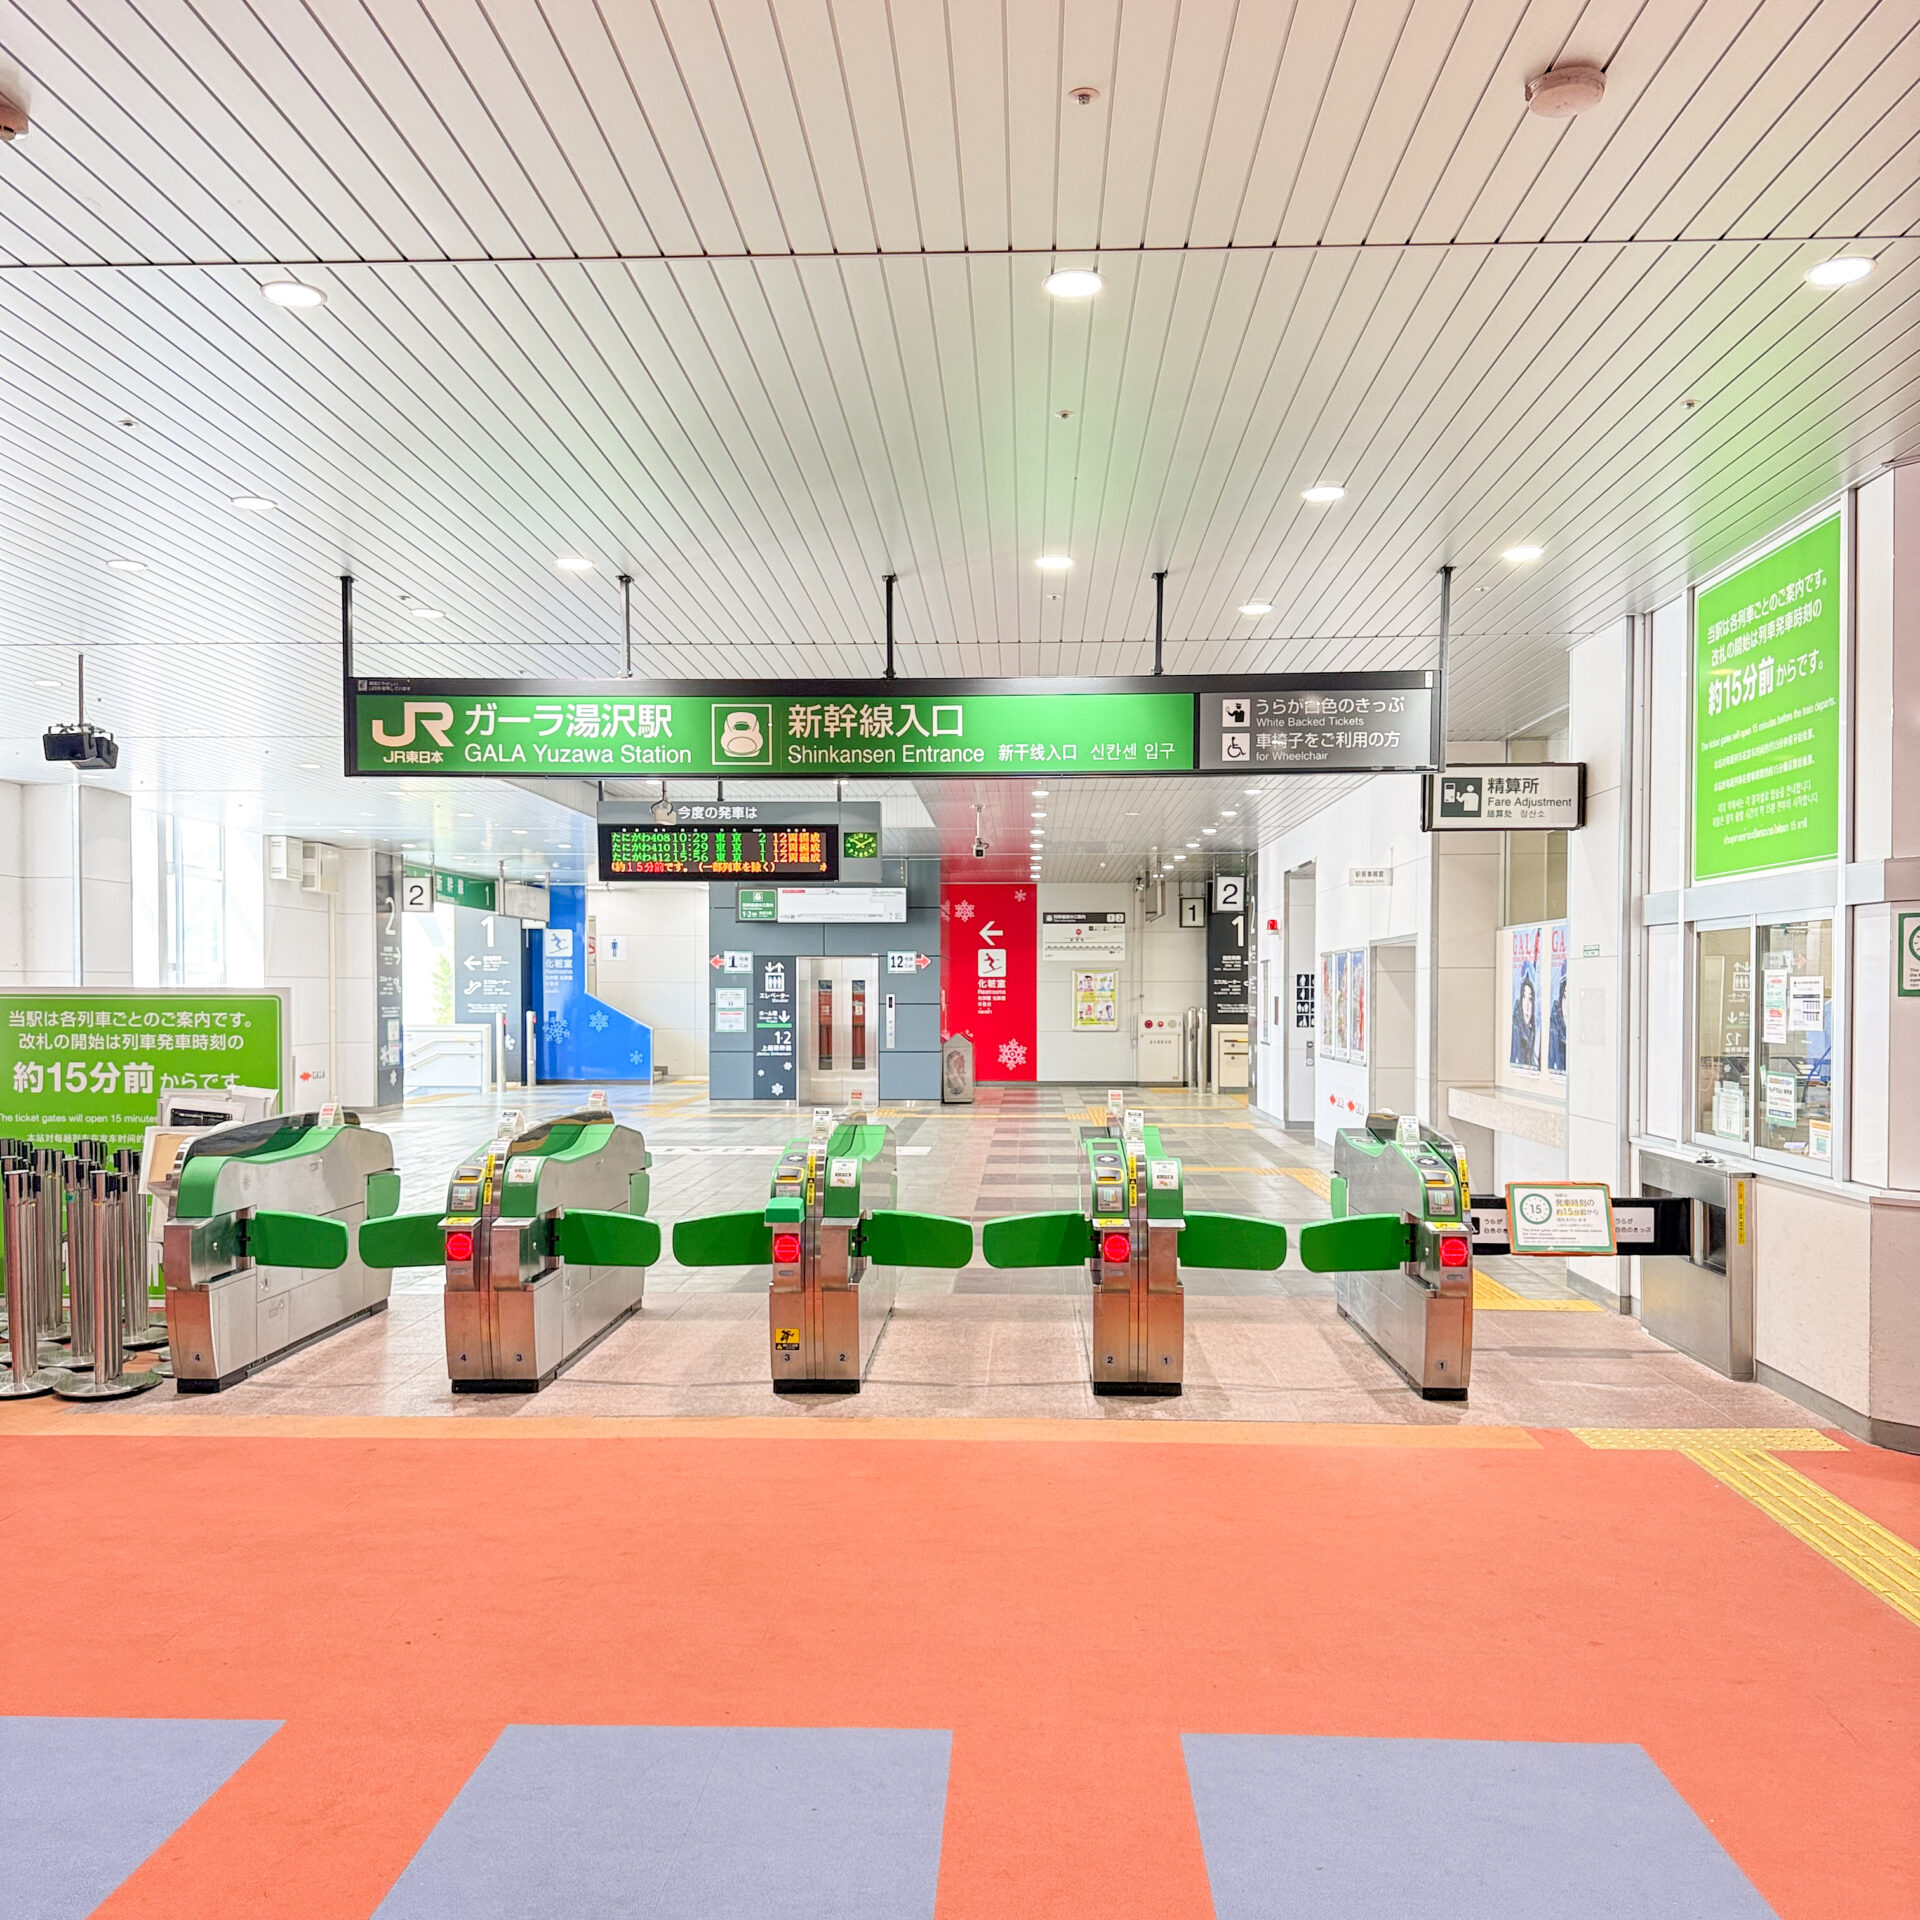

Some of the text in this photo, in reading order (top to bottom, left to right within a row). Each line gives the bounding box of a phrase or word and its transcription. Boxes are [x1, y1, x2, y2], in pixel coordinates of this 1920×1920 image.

[1707, 567, 1828, 645] 当駅は各列車ごとのご案内です。
[1711, 599, 1822, 667] 改札の開始は列車発車時刻の
[1256, 696, 1405, 715] うらが白色のきっぷ
[371, 701, 455, 748] JR
[464, 702, 673, 739] ガーラ湯沢駅
[788, 703, 963, 739] 新幹線入口
[1256, 716, 1364, 728] White Backed Tickets
[1256, 731, 1400, 750] 車椅子をご利用の方
[383, 750, 444, 765] JR東日本
[464, 744, 692, 764] GALA Yuzawa Station
[788, 744, 985, 764] Shinkansen Entrance
[998, 744, 1078, 762] 新干线入口
[1090, 742, 1176, 762] 신칸센 입구
[1256, 750, 1328, 761] for Wheelchair
[1487, 778, 1540, 794] 精算所
[1488, 796, 1572, 809] Fare Adjustment
[678, 806, 758, 820] 今度の発車は
[611, 832, 671, 843] たにがわ408
[672, 832, 708, 843] 10:29
[759, 832, 766, 843] 2
[611, 843, 671, 853] たにがわ410
[672, 843, 708, 853] 11:29
[759, 843, 766, 853] 1
[611, 853, 671, 863] たにがわ412
[672, 853, 708, 863] 15:56
[759, 853, 766, 863] 1
[410, 885, 424, 906] 2
[484, 886, 490, 906] 1
[1222, 884, 1238, 904] 2
[385, 896, 396, 935] 2
[1188, 904, 1196, 922] 1
[480, 916, 494, 948] 1
[1231, 915, 1244, 947] 1
[1513, 932, 1540, 956] GALA
[728, 956, 738, 968] 1
[890, 956, 904, 968] 12
[8, 1010, 252, 1028] 当駅は各列車ごとのご案内です。
[19, 1034, 244, 1051] 改札の開始は列車発車時刻の
[13, 1061, 246, 1094] 約15分前からです
[14, 1114, 39, 1122] ticket
[42, 1114, 66, 1124] gates
[69, 1114, 83, 1122] will
[86, 1116, 108, 1124] open
[111, 1114, 122, 1122] 15
[1530, 1204, 1542, 1214] 15
[194, 1354, 200, 1362] 4
[460, 1354, 467, 1362] 4
[516, 1354, 522, 1362] 3
[1440, 1362, 1444, 1370] 1
